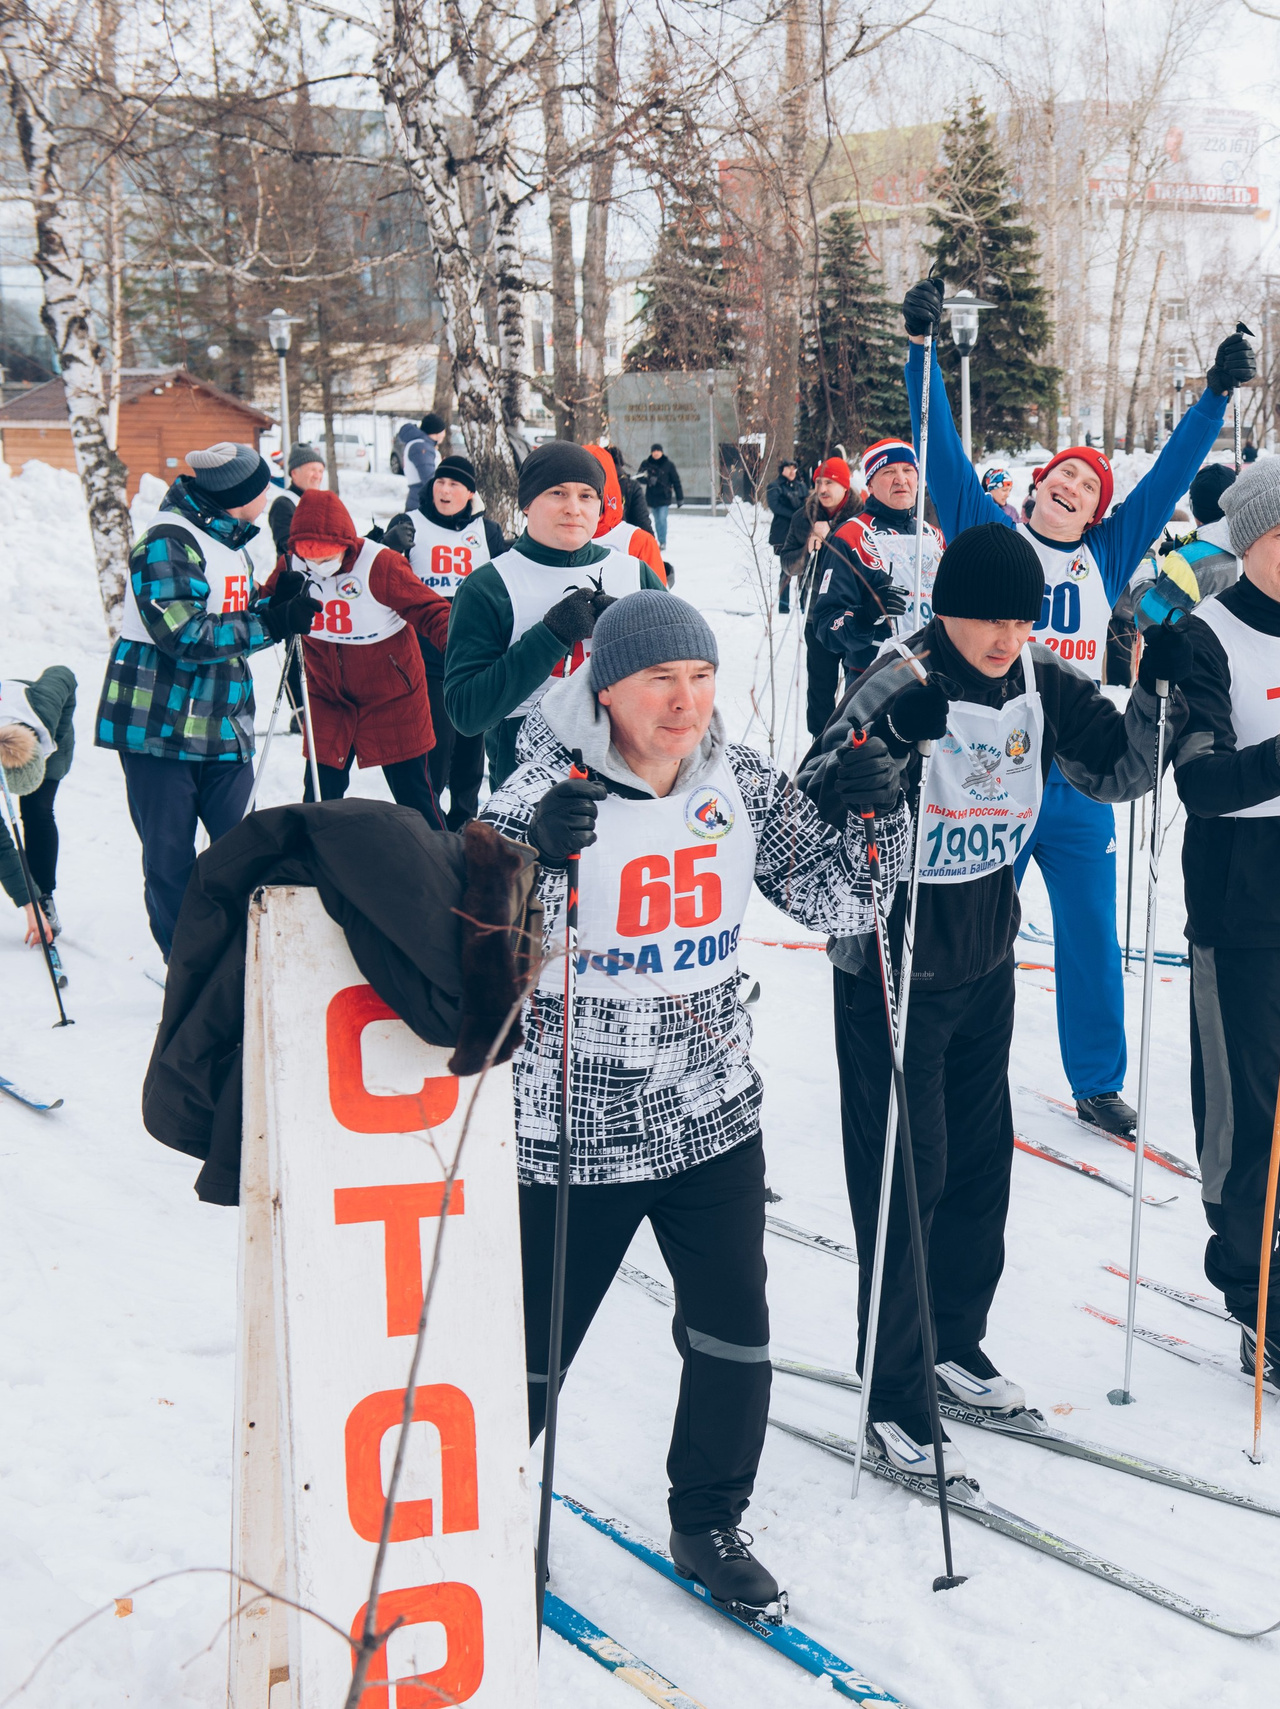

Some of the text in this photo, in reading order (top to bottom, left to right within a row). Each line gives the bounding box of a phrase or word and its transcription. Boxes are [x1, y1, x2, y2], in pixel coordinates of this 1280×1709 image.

[431, 545, 473, 576] 63
[969, 806, 1009, 817] РОССИИ
[926, 821, 1027, 867] 19951
[616, 843, 722, 938] 65
[918, 866, 966, 877] еспублика
[673, 923, 741, 972] 2009
[873, 880, 900, 1049] MADSHUS
[874, 1461, 927, 1493] FISCHER
